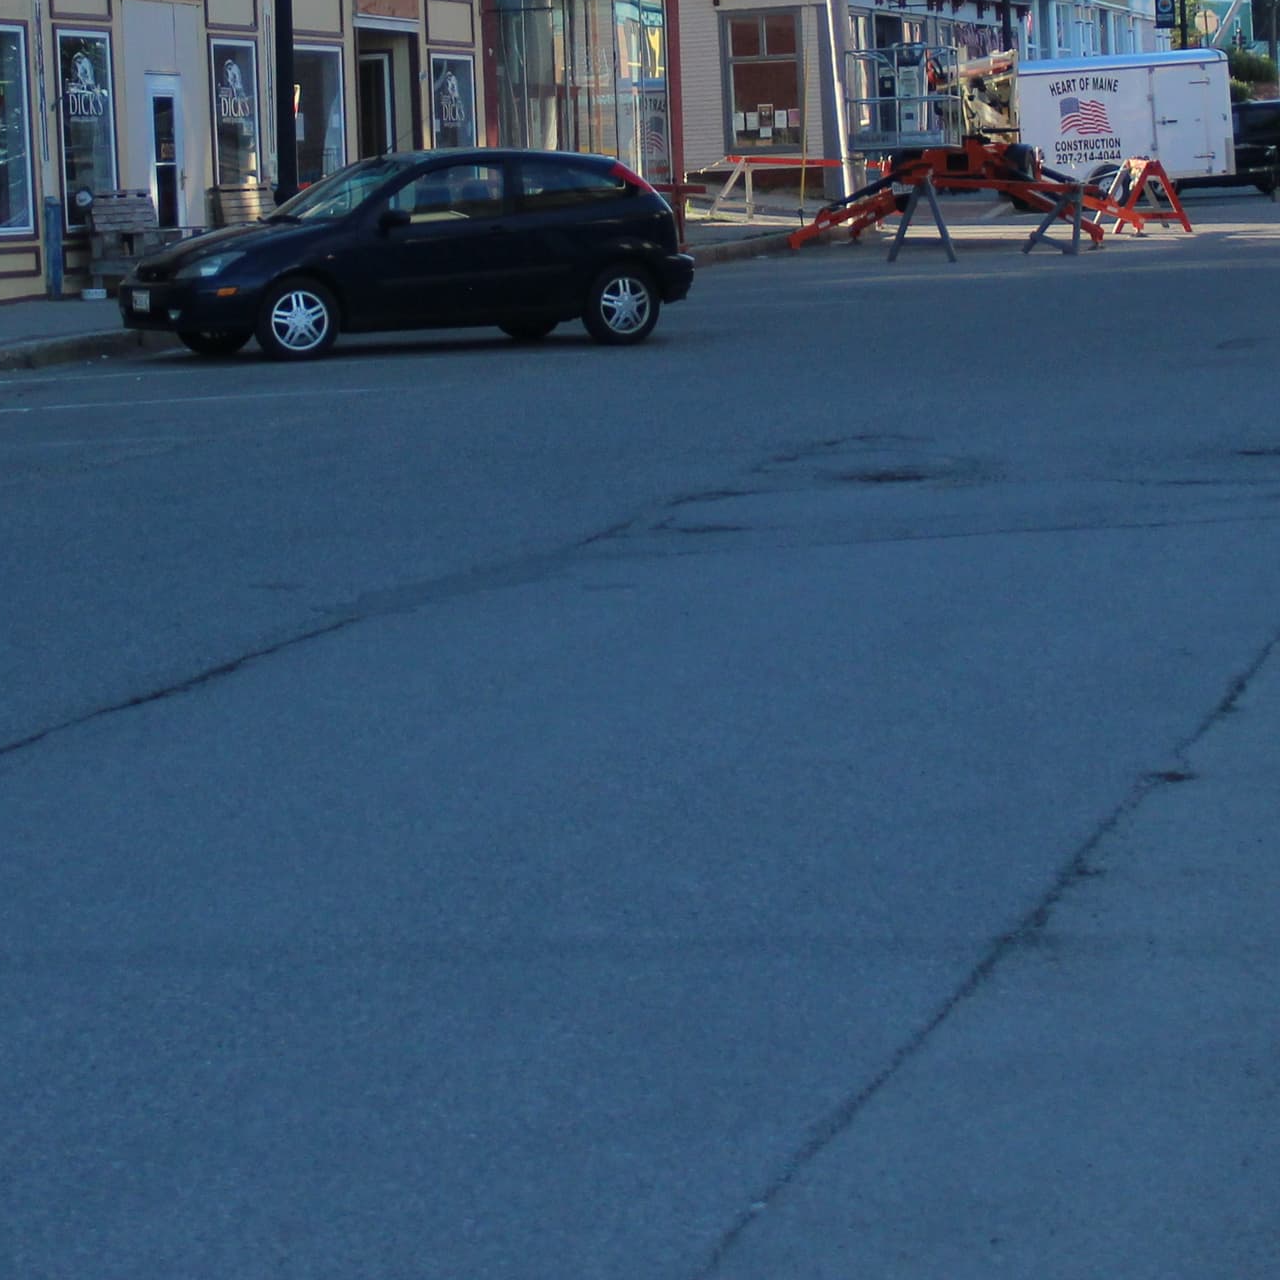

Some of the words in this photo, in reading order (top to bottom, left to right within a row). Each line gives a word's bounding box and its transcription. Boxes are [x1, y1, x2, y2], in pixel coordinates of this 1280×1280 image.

[1049, 78, 1077, 96] HEART
[1078, 77, 1090, 91] OF
[1092, 76, 1119, 93] MAINE
[1055, 137, 1121, 152] CONSTRUCTION
[1056, 150, 1121, 165] 207-214-4044
